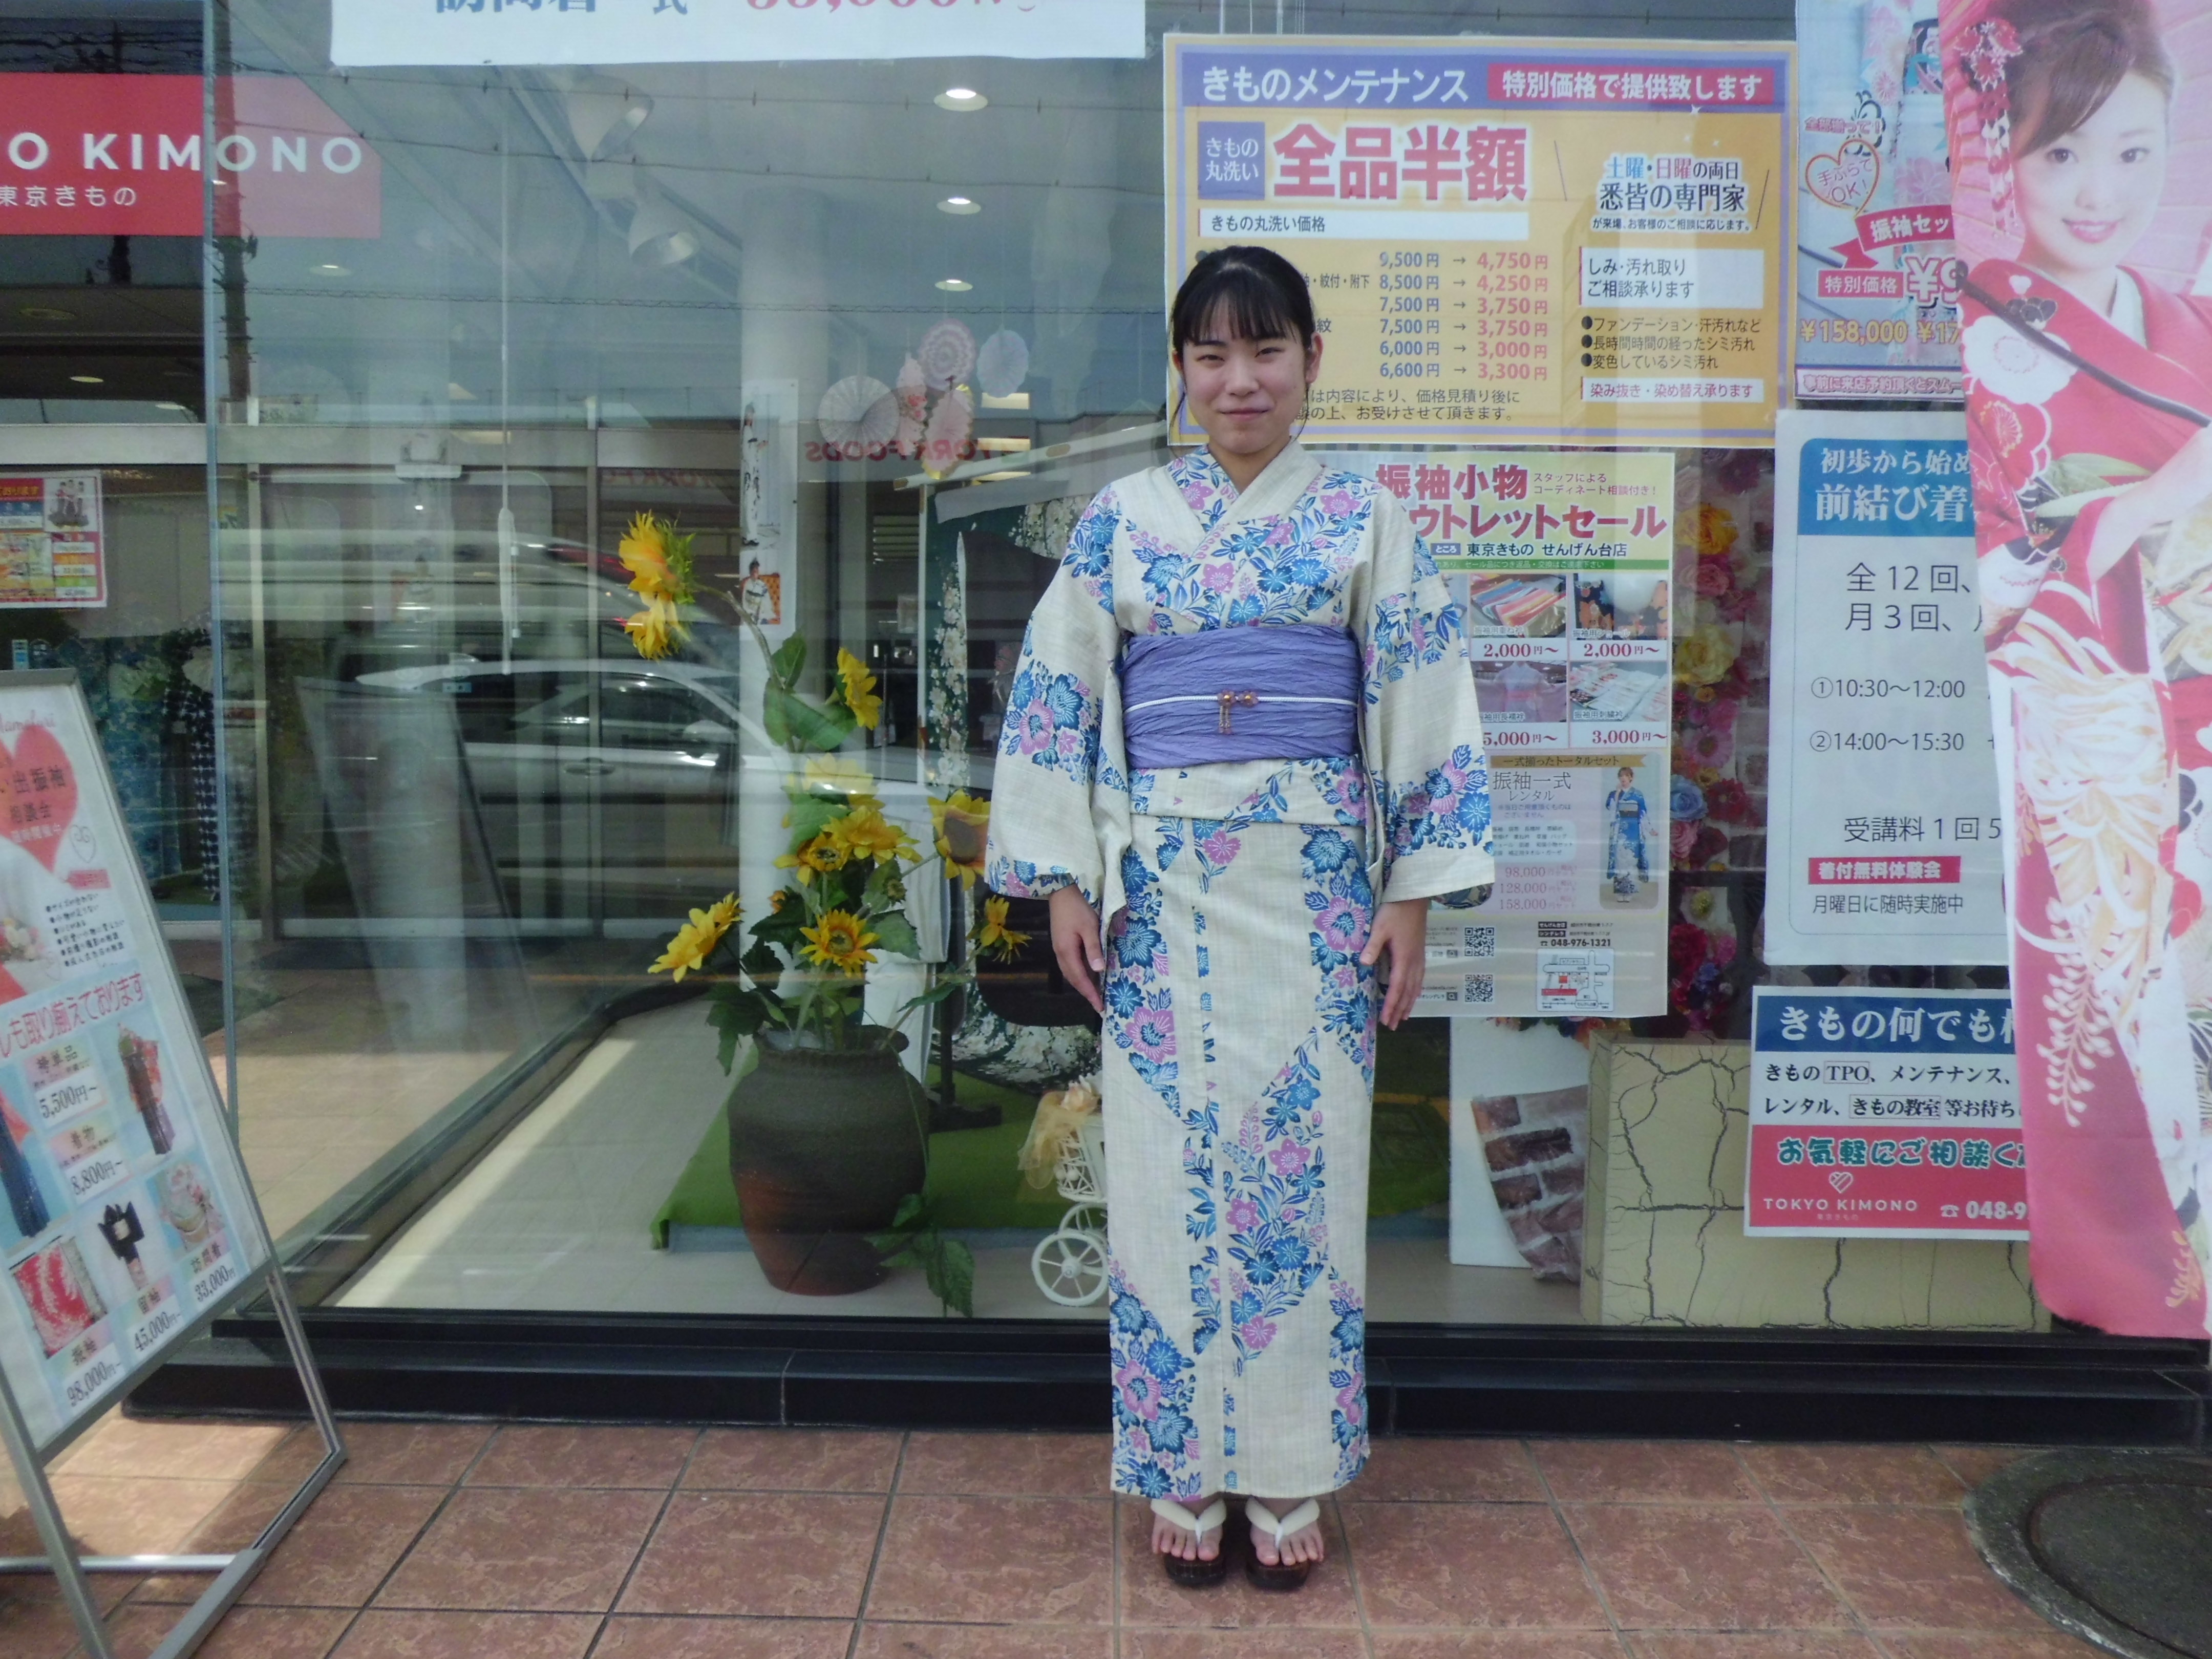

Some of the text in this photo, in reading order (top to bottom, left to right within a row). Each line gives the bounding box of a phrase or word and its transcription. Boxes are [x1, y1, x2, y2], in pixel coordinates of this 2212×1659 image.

[1203, 66, 1762, 103] きものメンテナンス 特別価格で提供致します
[83, 132, 362, 174] KIMONO
[1205, 138, 1259, 158] きもの
[1205, 161, 1259, 181] 丸洗い
[1273, 123, 1527, 201] 全品半額
[1607, 157, 1738, 180] 土曜・日曜の両日
[0, 186, 136, 207] 東京きもの
[1600, 183, 1745, 212] 悉皆の専門家
[1211, 215, 1325, 232] きもの丸洗い価格
[1379, 252, 1548, 270] 9,500円 4,750円
[1588, 258, 1686, 275] しみ・汚れ取り
[1379, 274, 1439, 292] 8,500円
[1477, 274, 1548, 293] 4,250円
[1588, 280, 1694, 298] ご相談承ります
[1825, 275, 1898, 294] 特別価格
[1379, 296, 1548, 315] 7,500円 3,750円
[1379, 318, 1439, 335] 7,500円
[1477, 319, 1548, 337] 3,750円
[1593, 317, 1761, 333] ファンデーション・汗汚れなど
[1800, 318, 1908, 346] ¥158,000
[1379, 341, 1548, 359] 6,000円 3,000円
[1593, 336, 1755, 352] 長時間時間の経ったシミ汚れ
[1379, 363, 1548, 381] 6,600円 3,300円
[1592, 355, 1718, 370] 変色しているシミ汚れ
[1590, 383, 1753, 398] 染み抜き・染め替え承ります
[1820, 448, 1970, 475] 初歩から始め
[1534, 473, 1607, 483] スタッフによる
[1815, 483, 1968, 522] 前結び着
[1401, 504, 1668, 539] ウトレットセール
[1435, 543, 1627, 557] ところ 東京きもの せんげん台店
[1503, 755, 1620, 767] 一式揃ったトータルセット
[1492, 771, 1571, 791] 振袖一式
[1508, 790, 1555, 801] レンタル
[1818, 860, 1941, 880] 着付無料体験会
[1813, 894, 1964, 914] 月曜日に随時実施中
[1550, 939, 1611, 947] 048-976-1321
[1763, 1198, 1918, 1211] TOKYO KIMONO
